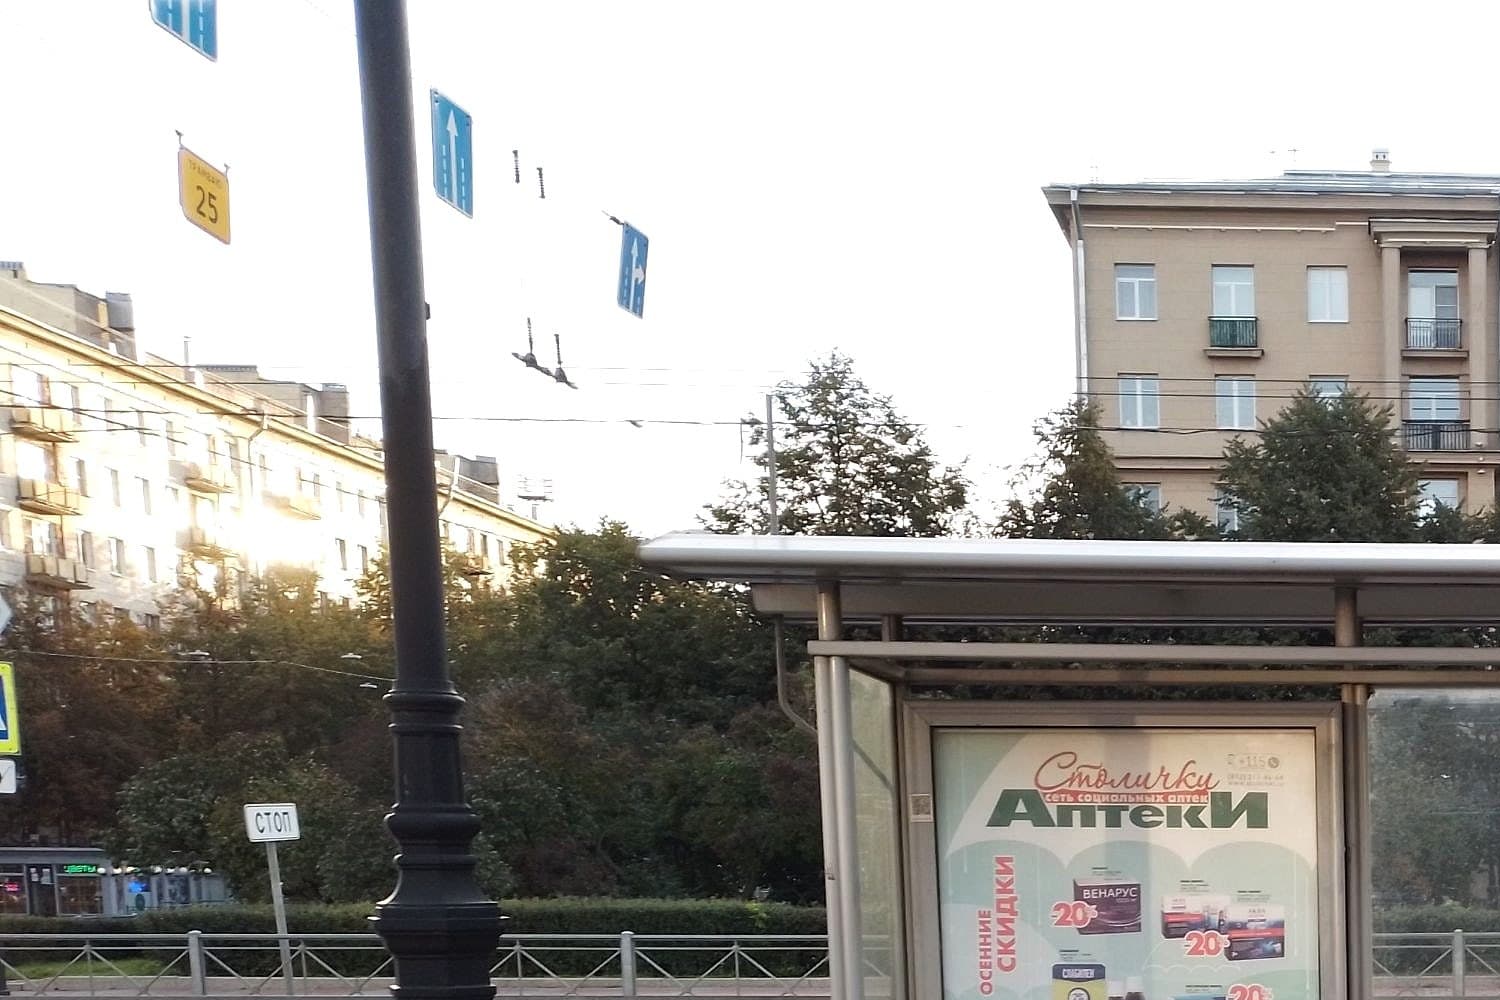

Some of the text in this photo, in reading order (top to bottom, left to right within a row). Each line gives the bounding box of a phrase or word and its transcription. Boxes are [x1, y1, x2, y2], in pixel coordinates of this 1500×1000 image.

[196, 185, 218, 224] 25
[1034, 751, 1221, 792] Столички
[1045, 792, 1209, 804] сеть социальных аптек
[255, 811, 292, 834] СТОП
[1082, 887, 1138, 899] ВЕНАРУС
[995, 856, 1018, 973] СКИДКИ
[978, 910, 993, 995] ОСЕННИЕ
